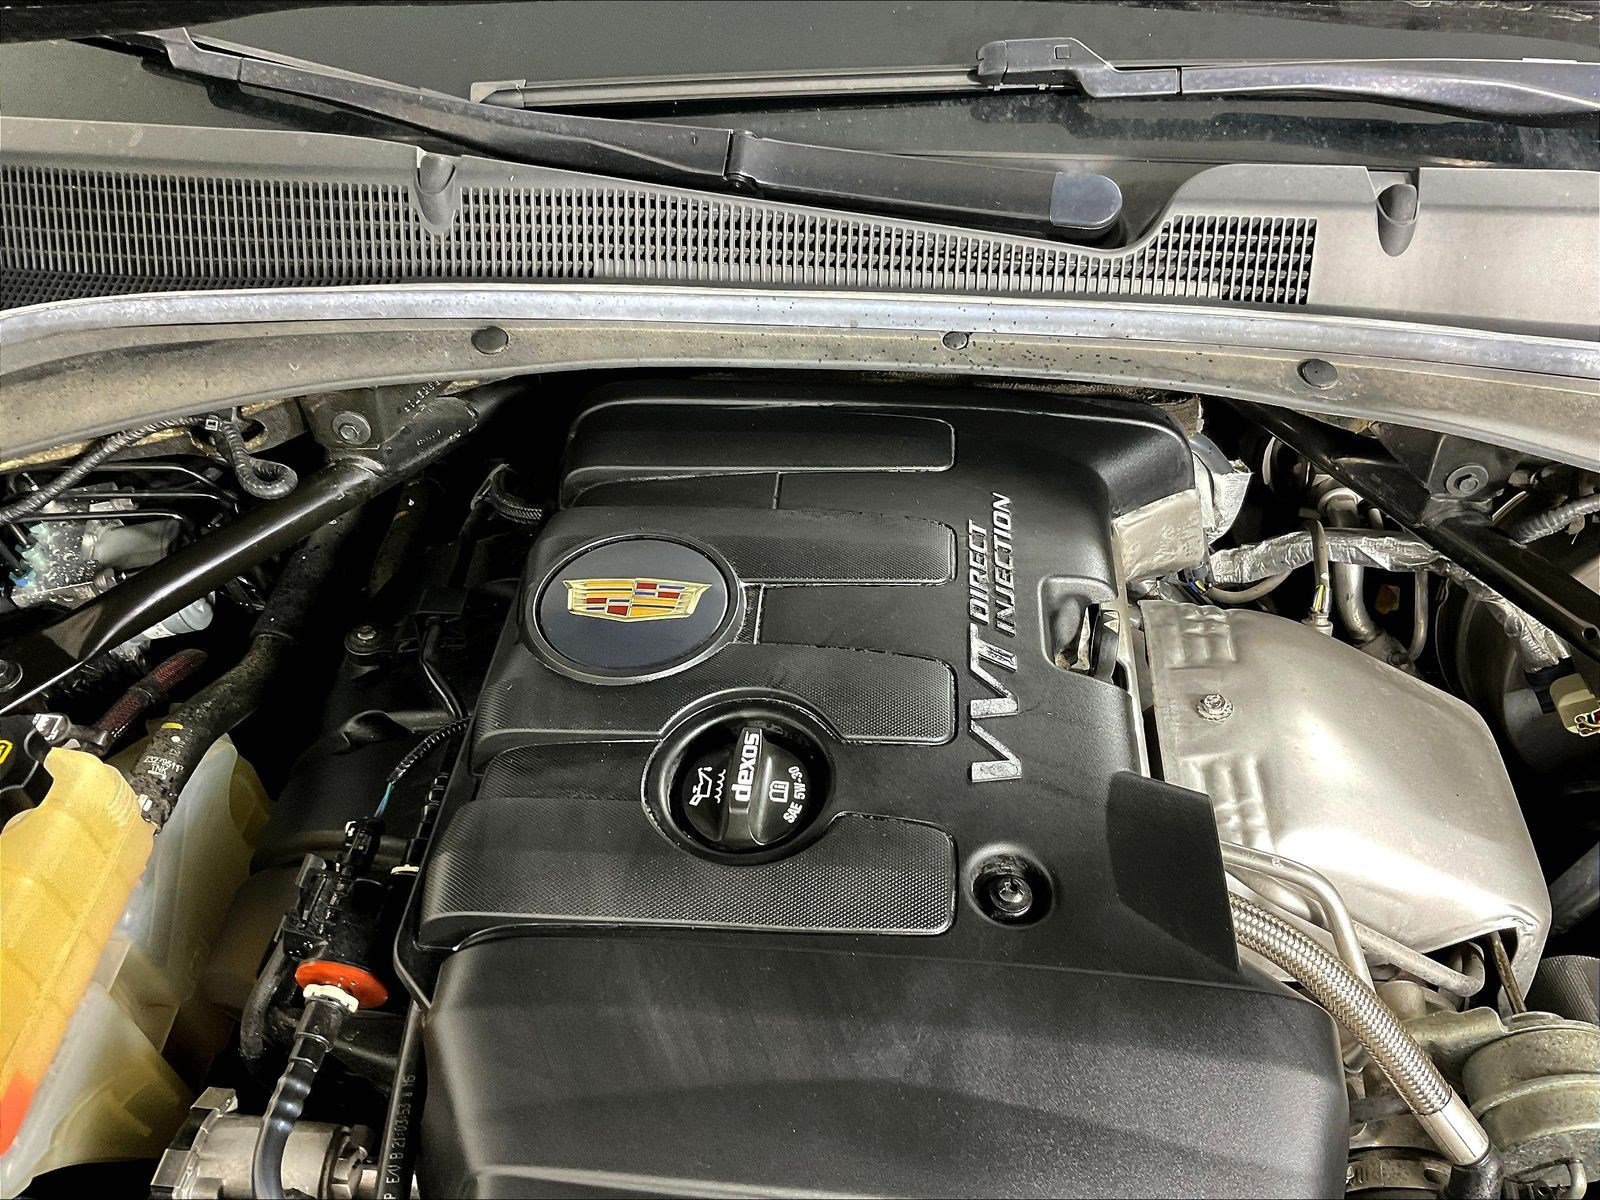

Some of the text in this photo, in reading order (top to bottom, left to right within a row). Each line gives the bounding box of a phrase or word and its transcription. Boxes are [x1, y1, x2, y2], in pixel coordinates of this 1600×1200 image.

[969, 518, 989, 625] DIRECT
[992, 491, 1016, 637] INJECTION
[969, 622, 1021, 783] VVT
[731, 731, 760, 802] dexos
[783, 765, 806, 824] SAE 5W-30
